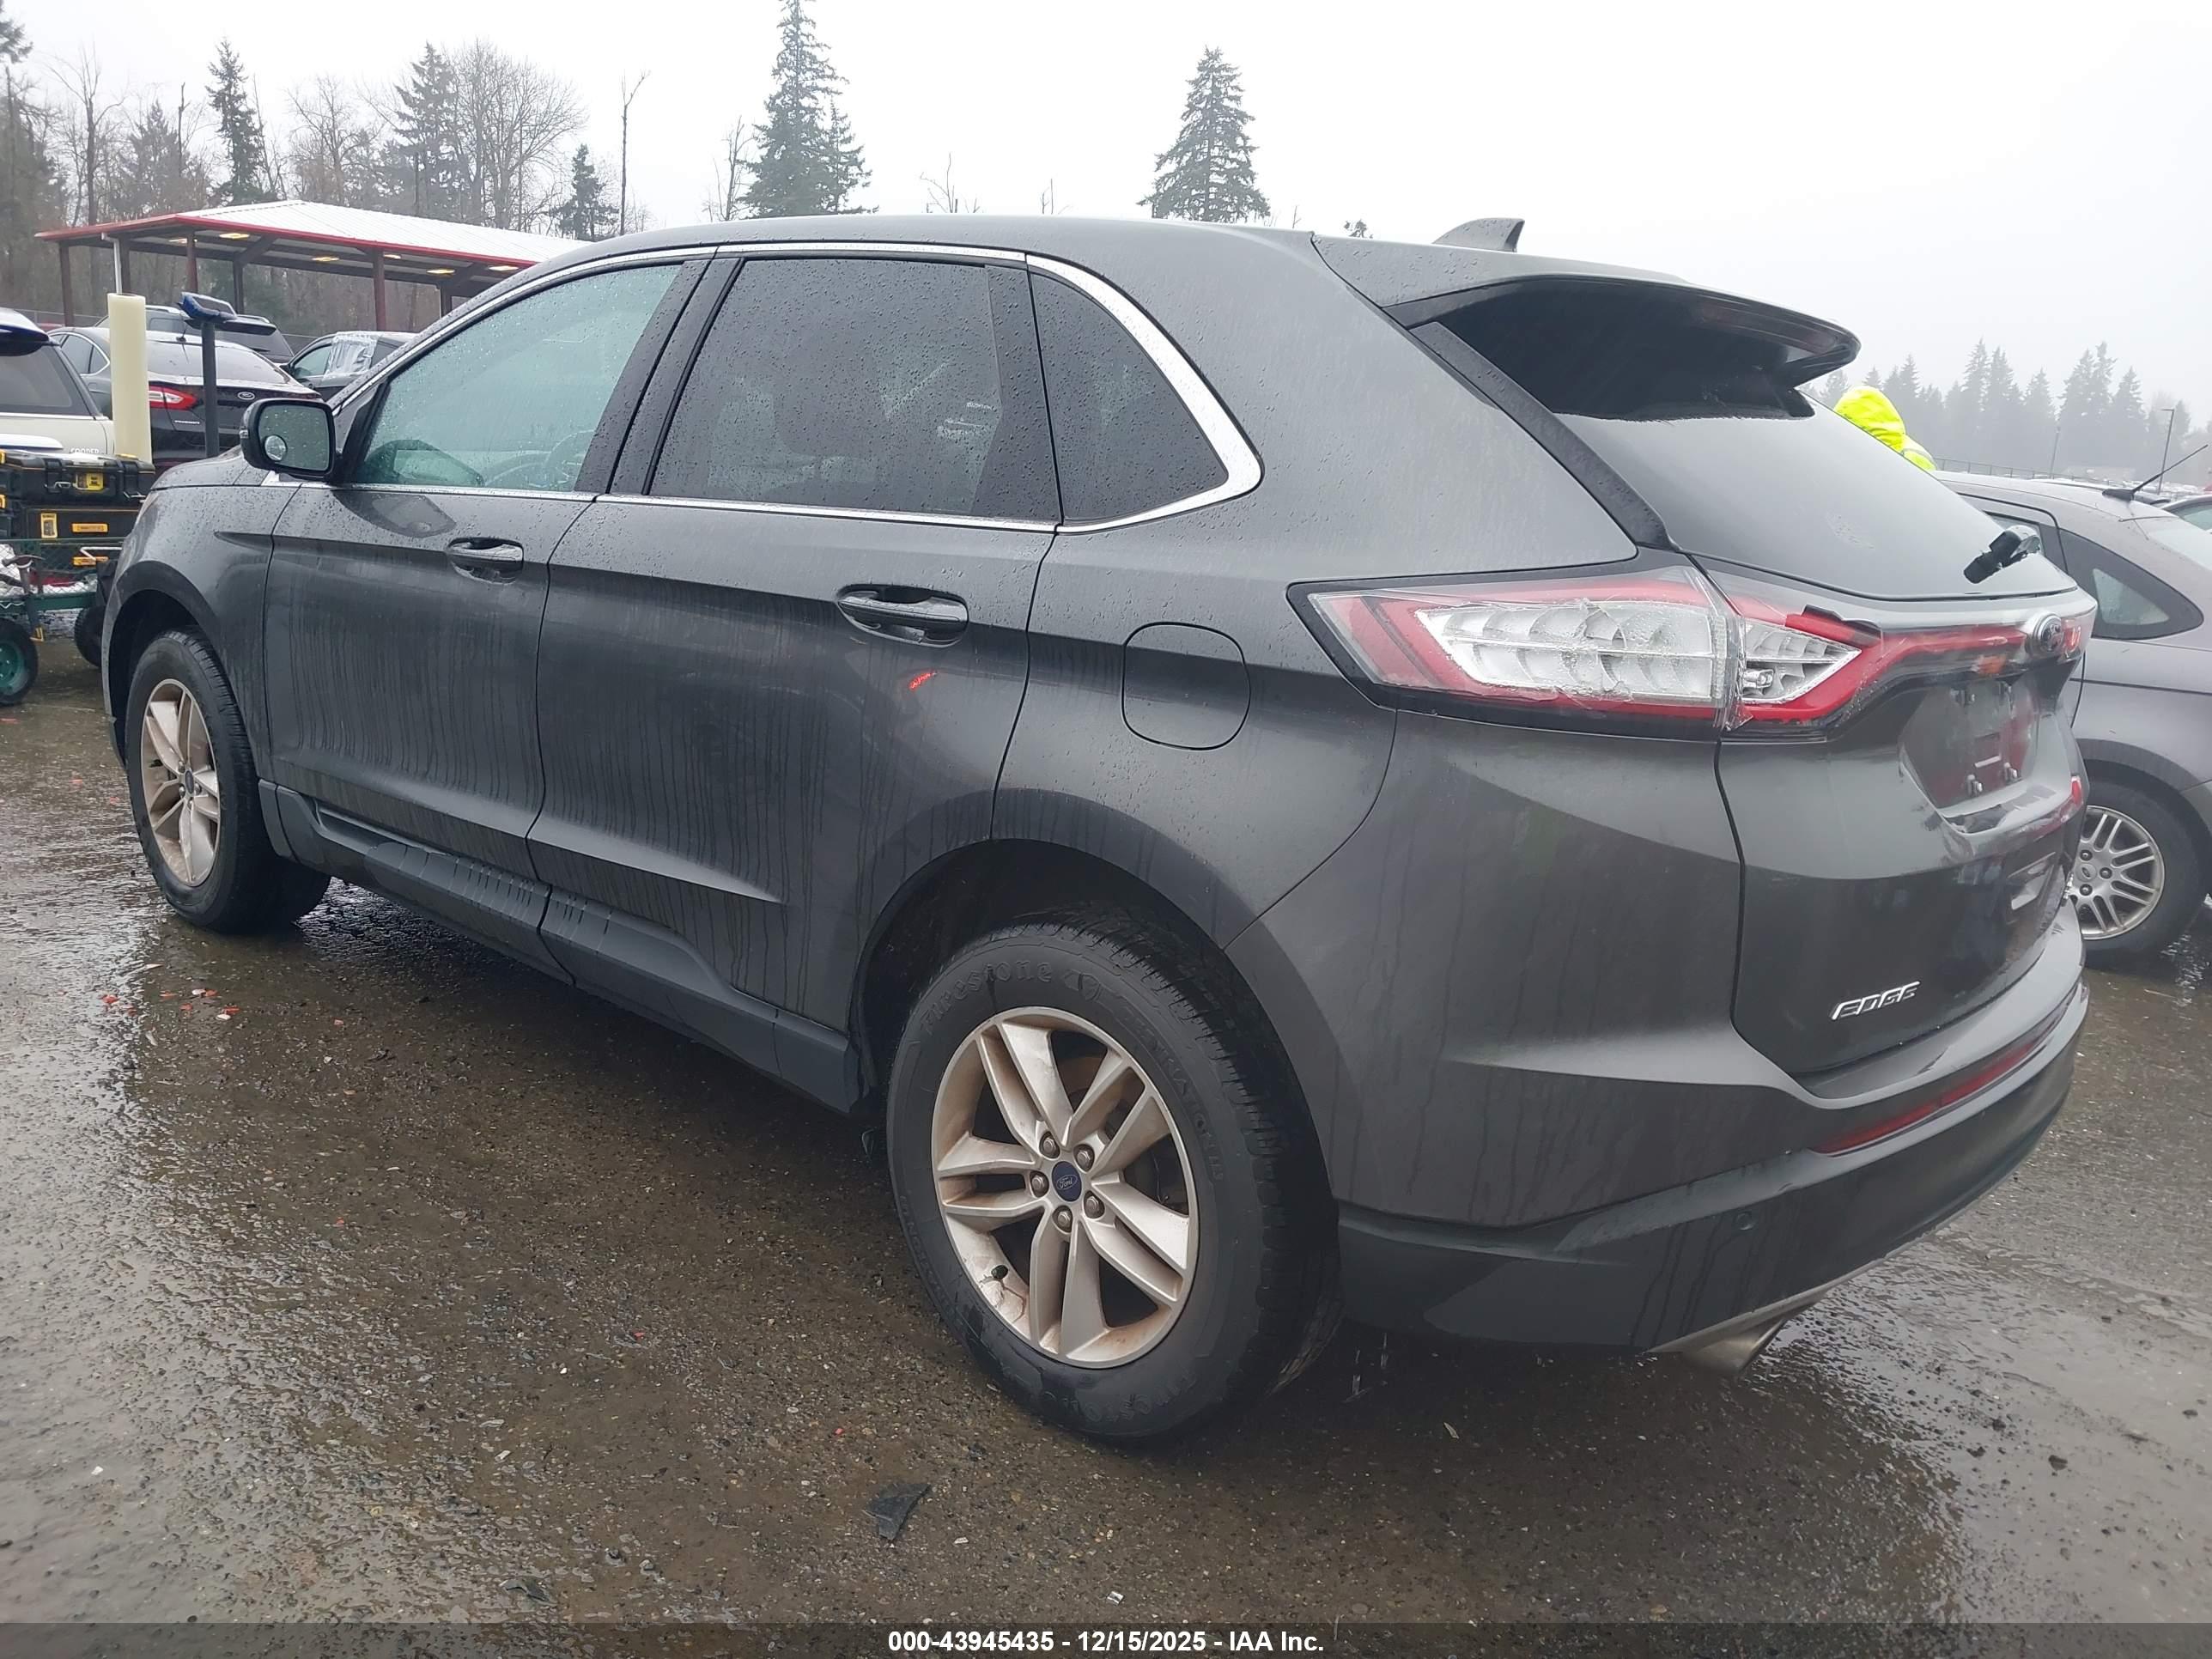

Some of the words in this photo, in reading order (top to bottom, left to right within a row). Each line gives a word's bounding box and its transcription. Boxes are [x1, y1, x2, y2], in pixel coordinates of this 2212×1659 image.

[921, 960, 1052, 1035] Firestone
[1830, 981, 1921, 1020] EDGE
[1057, 1175, 1075, 1189] Ford
